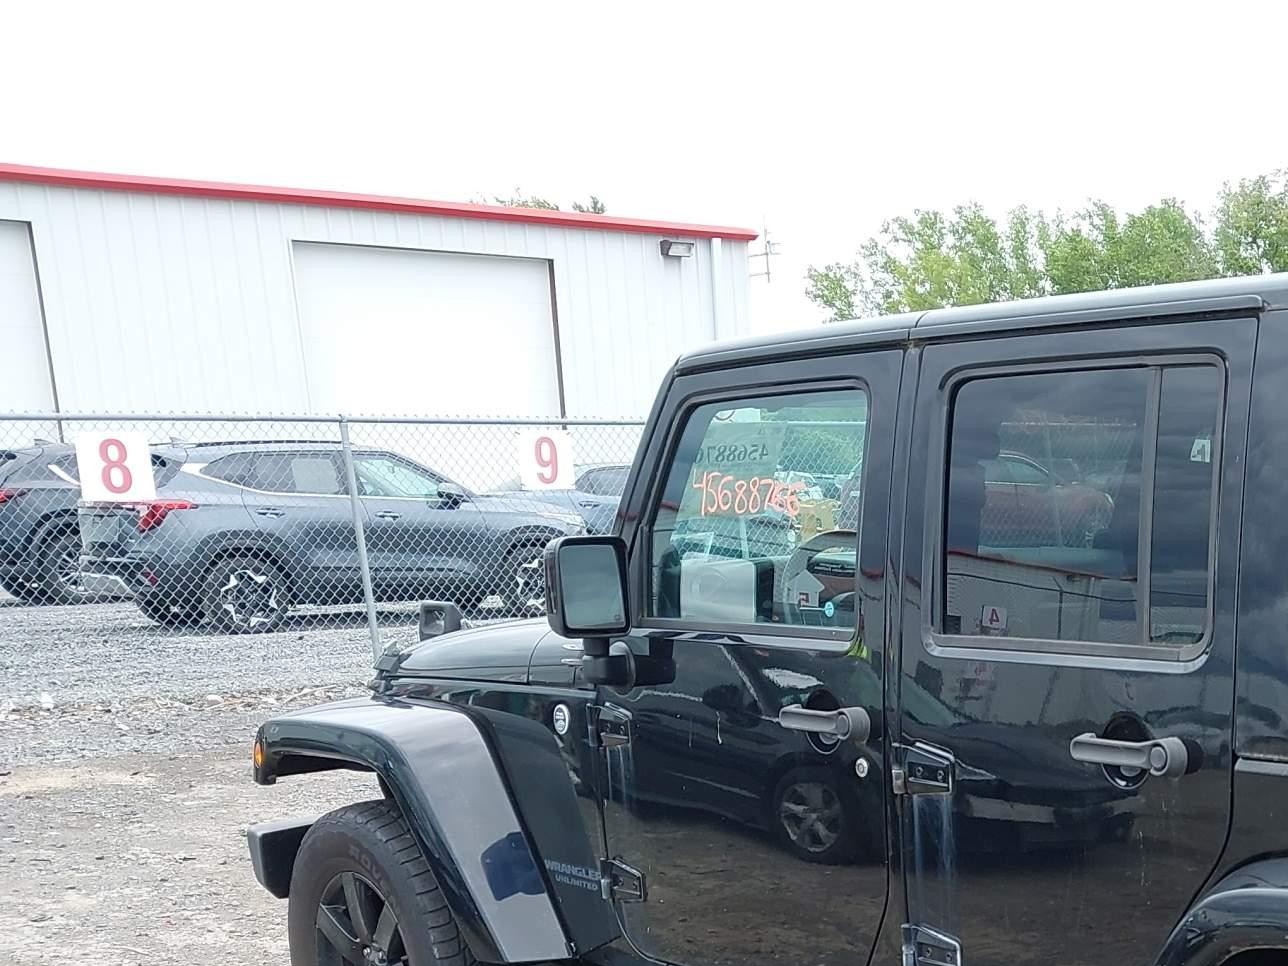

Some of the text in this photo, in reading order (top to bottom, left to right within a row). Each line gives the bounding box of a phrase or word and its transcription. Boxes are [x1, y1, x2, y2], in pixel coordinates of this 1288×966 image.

[99, 438, 134, 494] 8
[533, 436, 559, 485] 9
[555, 874, 598, 891] UNLIMITED
